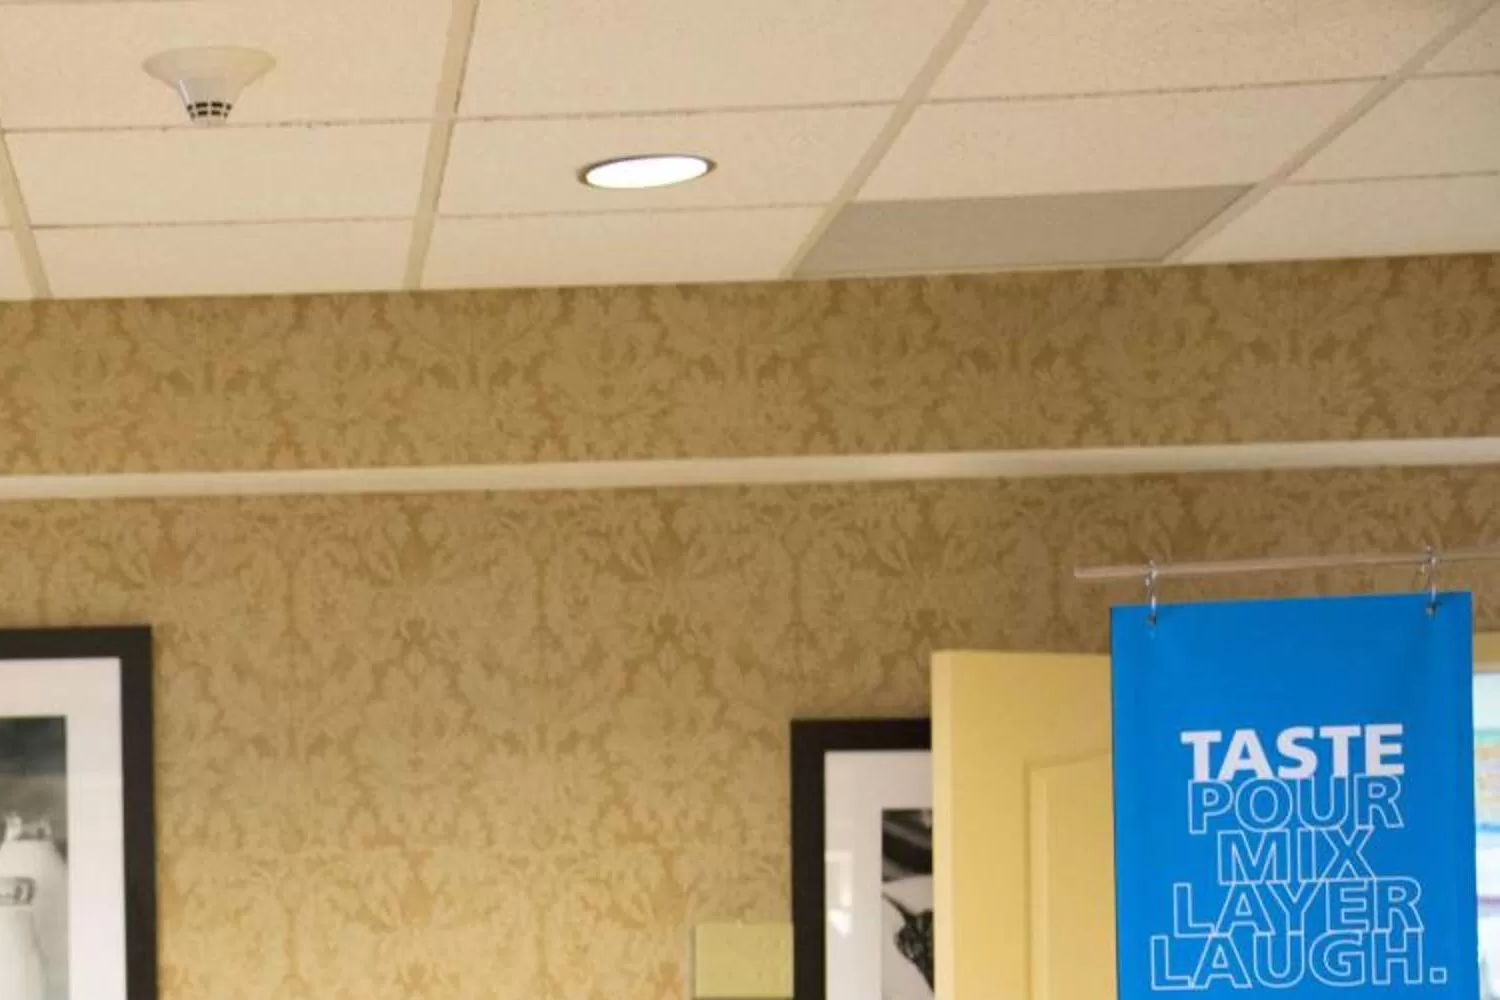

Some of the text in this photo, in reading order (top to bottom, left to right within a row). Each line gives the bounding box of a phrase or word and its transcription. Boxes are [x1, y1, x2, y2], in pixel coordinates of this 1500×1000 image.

[1180, 724, 1405, 782] TASTE
[1188, 774, 1404, 834] POUR
[1217, 826, 1376, 886] MIX
[1173, 876, 1424, 937] LAYER
[1151, 929, 1448, 990] LAUGH.
